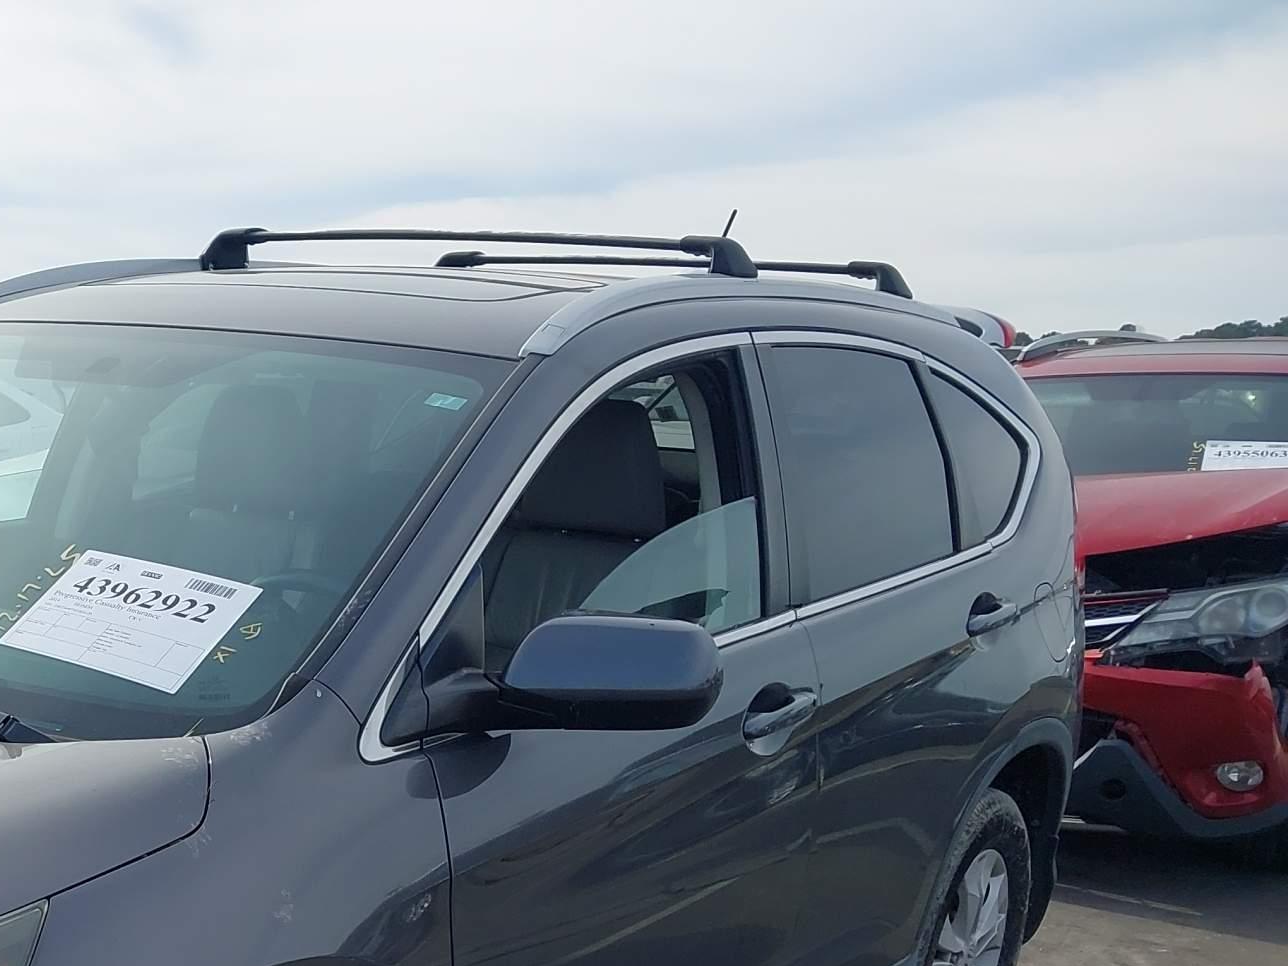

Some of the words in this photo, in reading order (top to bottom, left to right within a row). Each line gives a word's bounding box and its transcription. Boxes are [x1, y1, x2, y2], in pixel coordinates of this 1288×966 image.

[53, 590, 94, 603] Progressive
[94, 598, 125, 611] Casualty
[126, 607, 162, 620] Insurance
[73, 576, 216, 624] 43962922
